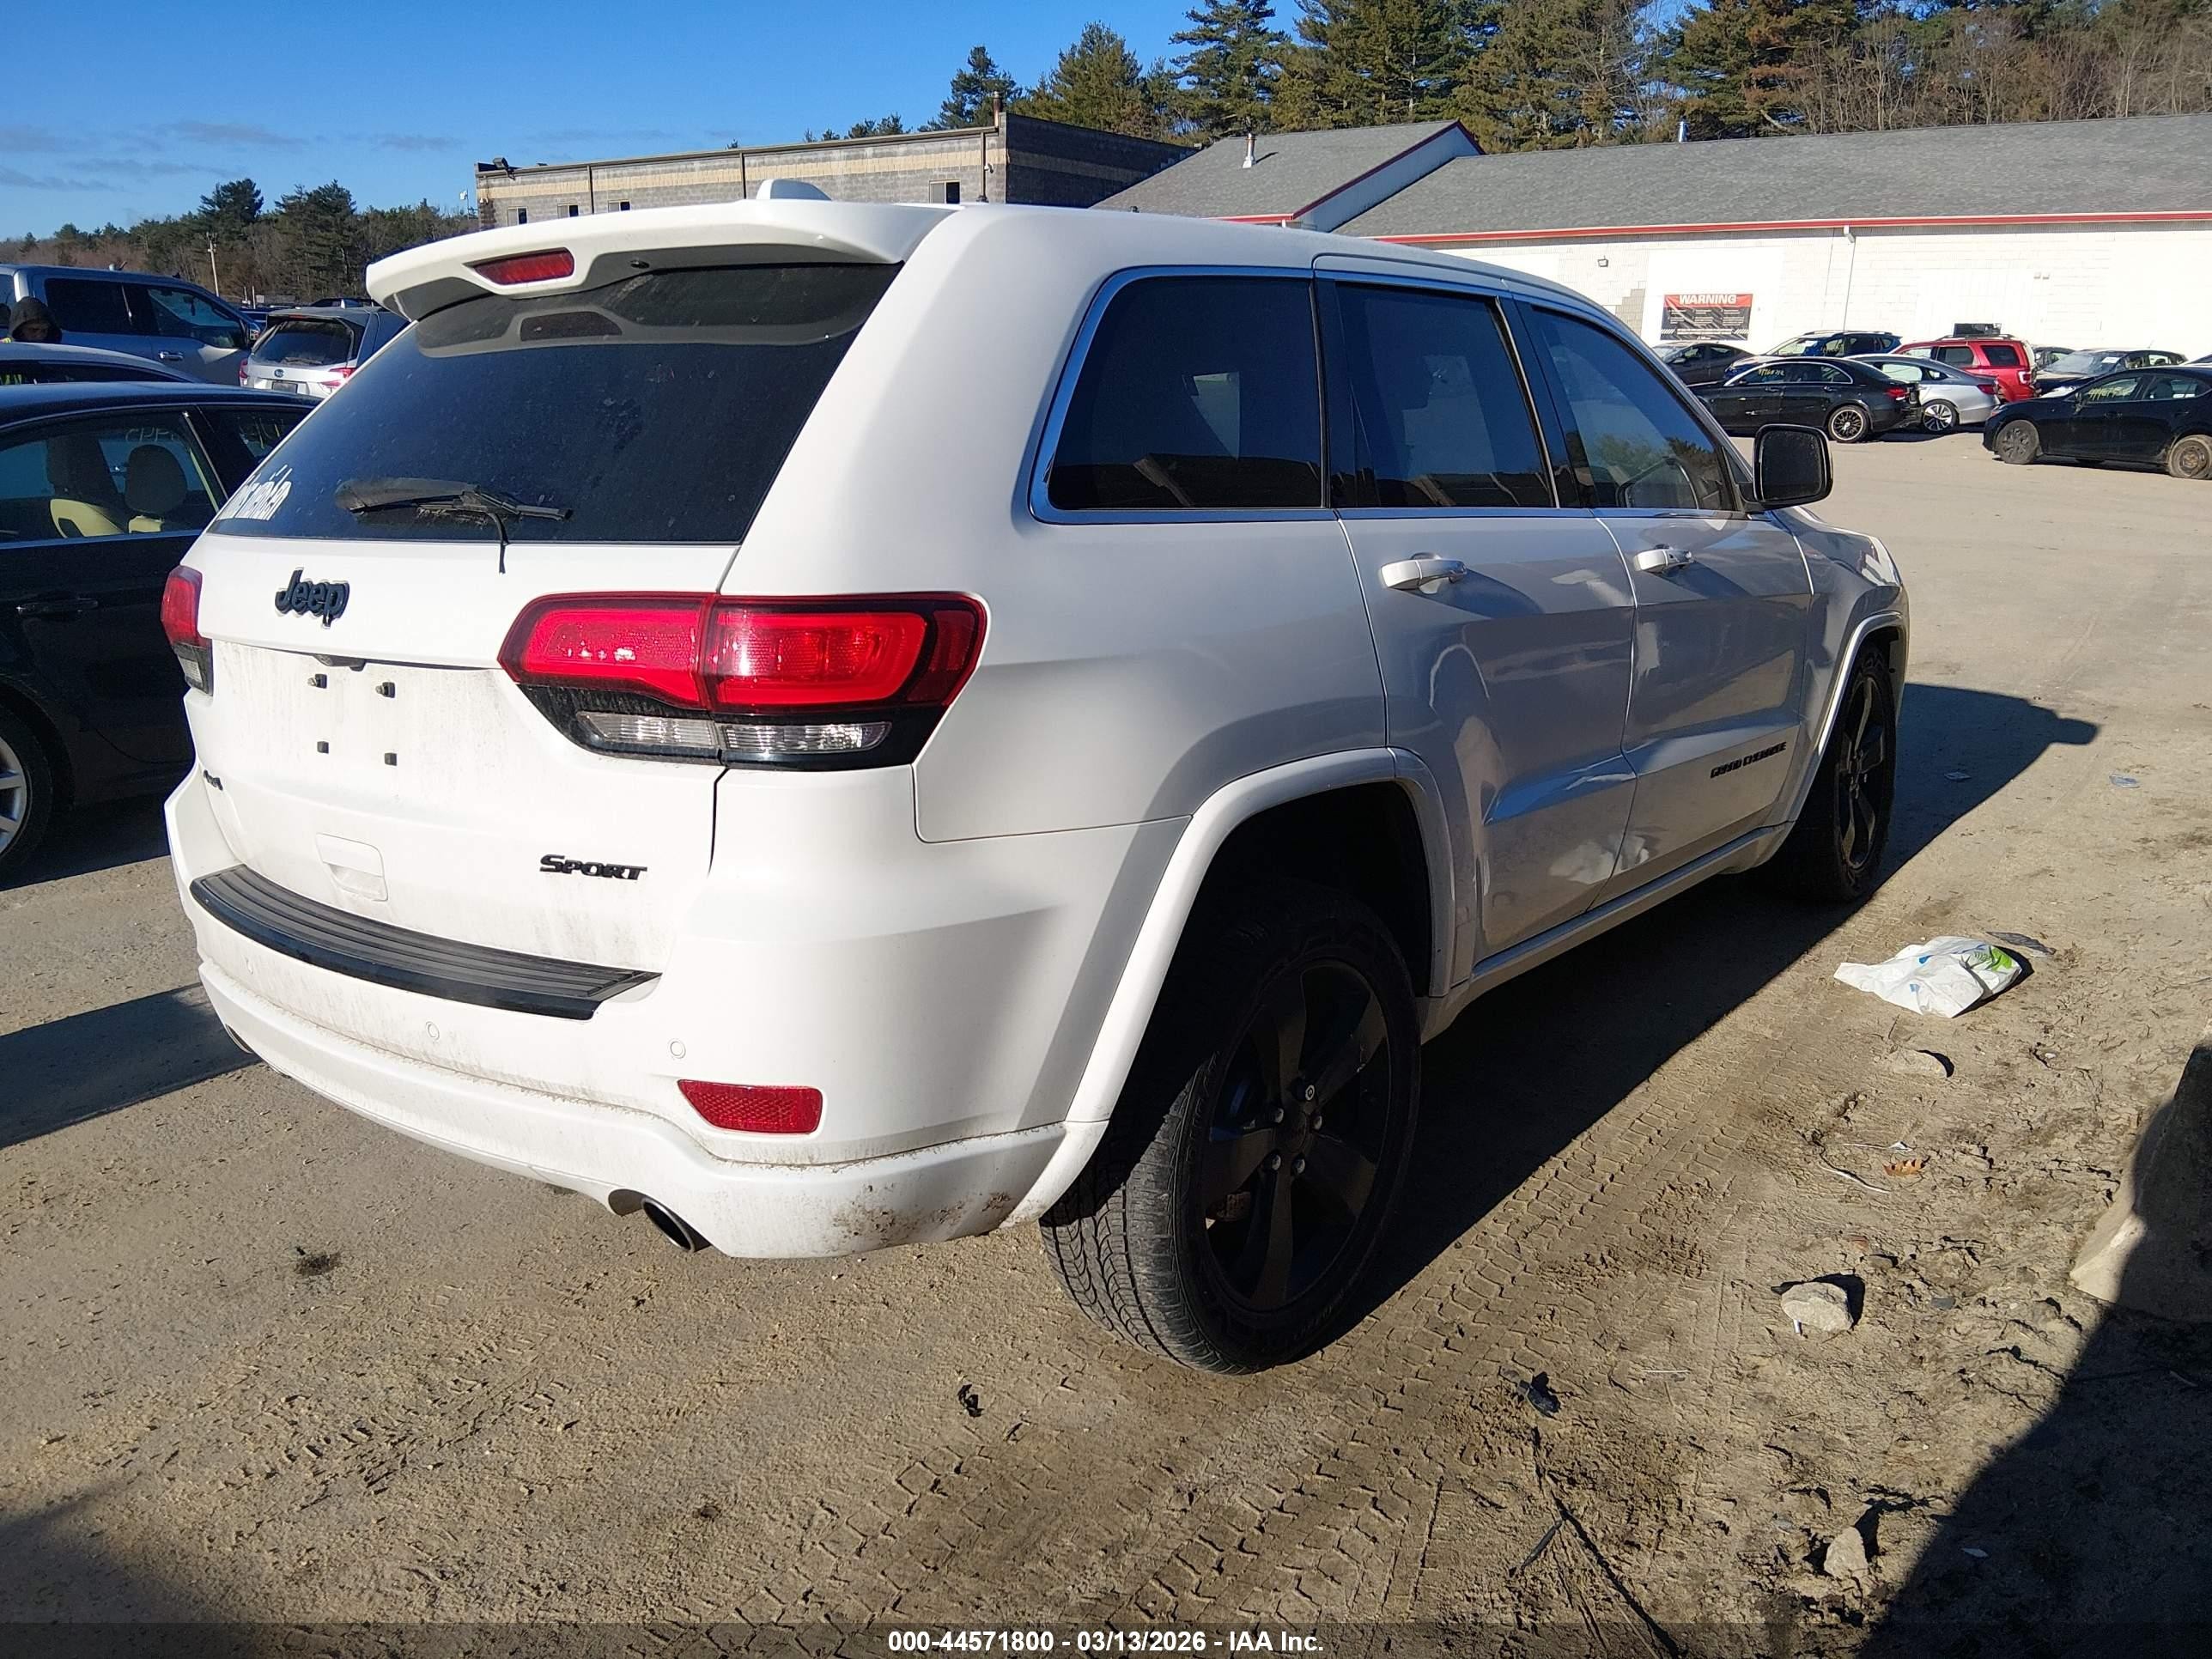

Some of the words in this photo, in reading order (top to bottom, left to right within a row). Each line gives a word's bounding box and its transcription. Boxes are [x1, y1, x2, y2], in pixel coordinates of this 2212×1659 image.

[1679, 294, 1737, 305] WARNING
[274, 568, 350, 628] Jeep
[539, 854, 647, 880] SPORT
